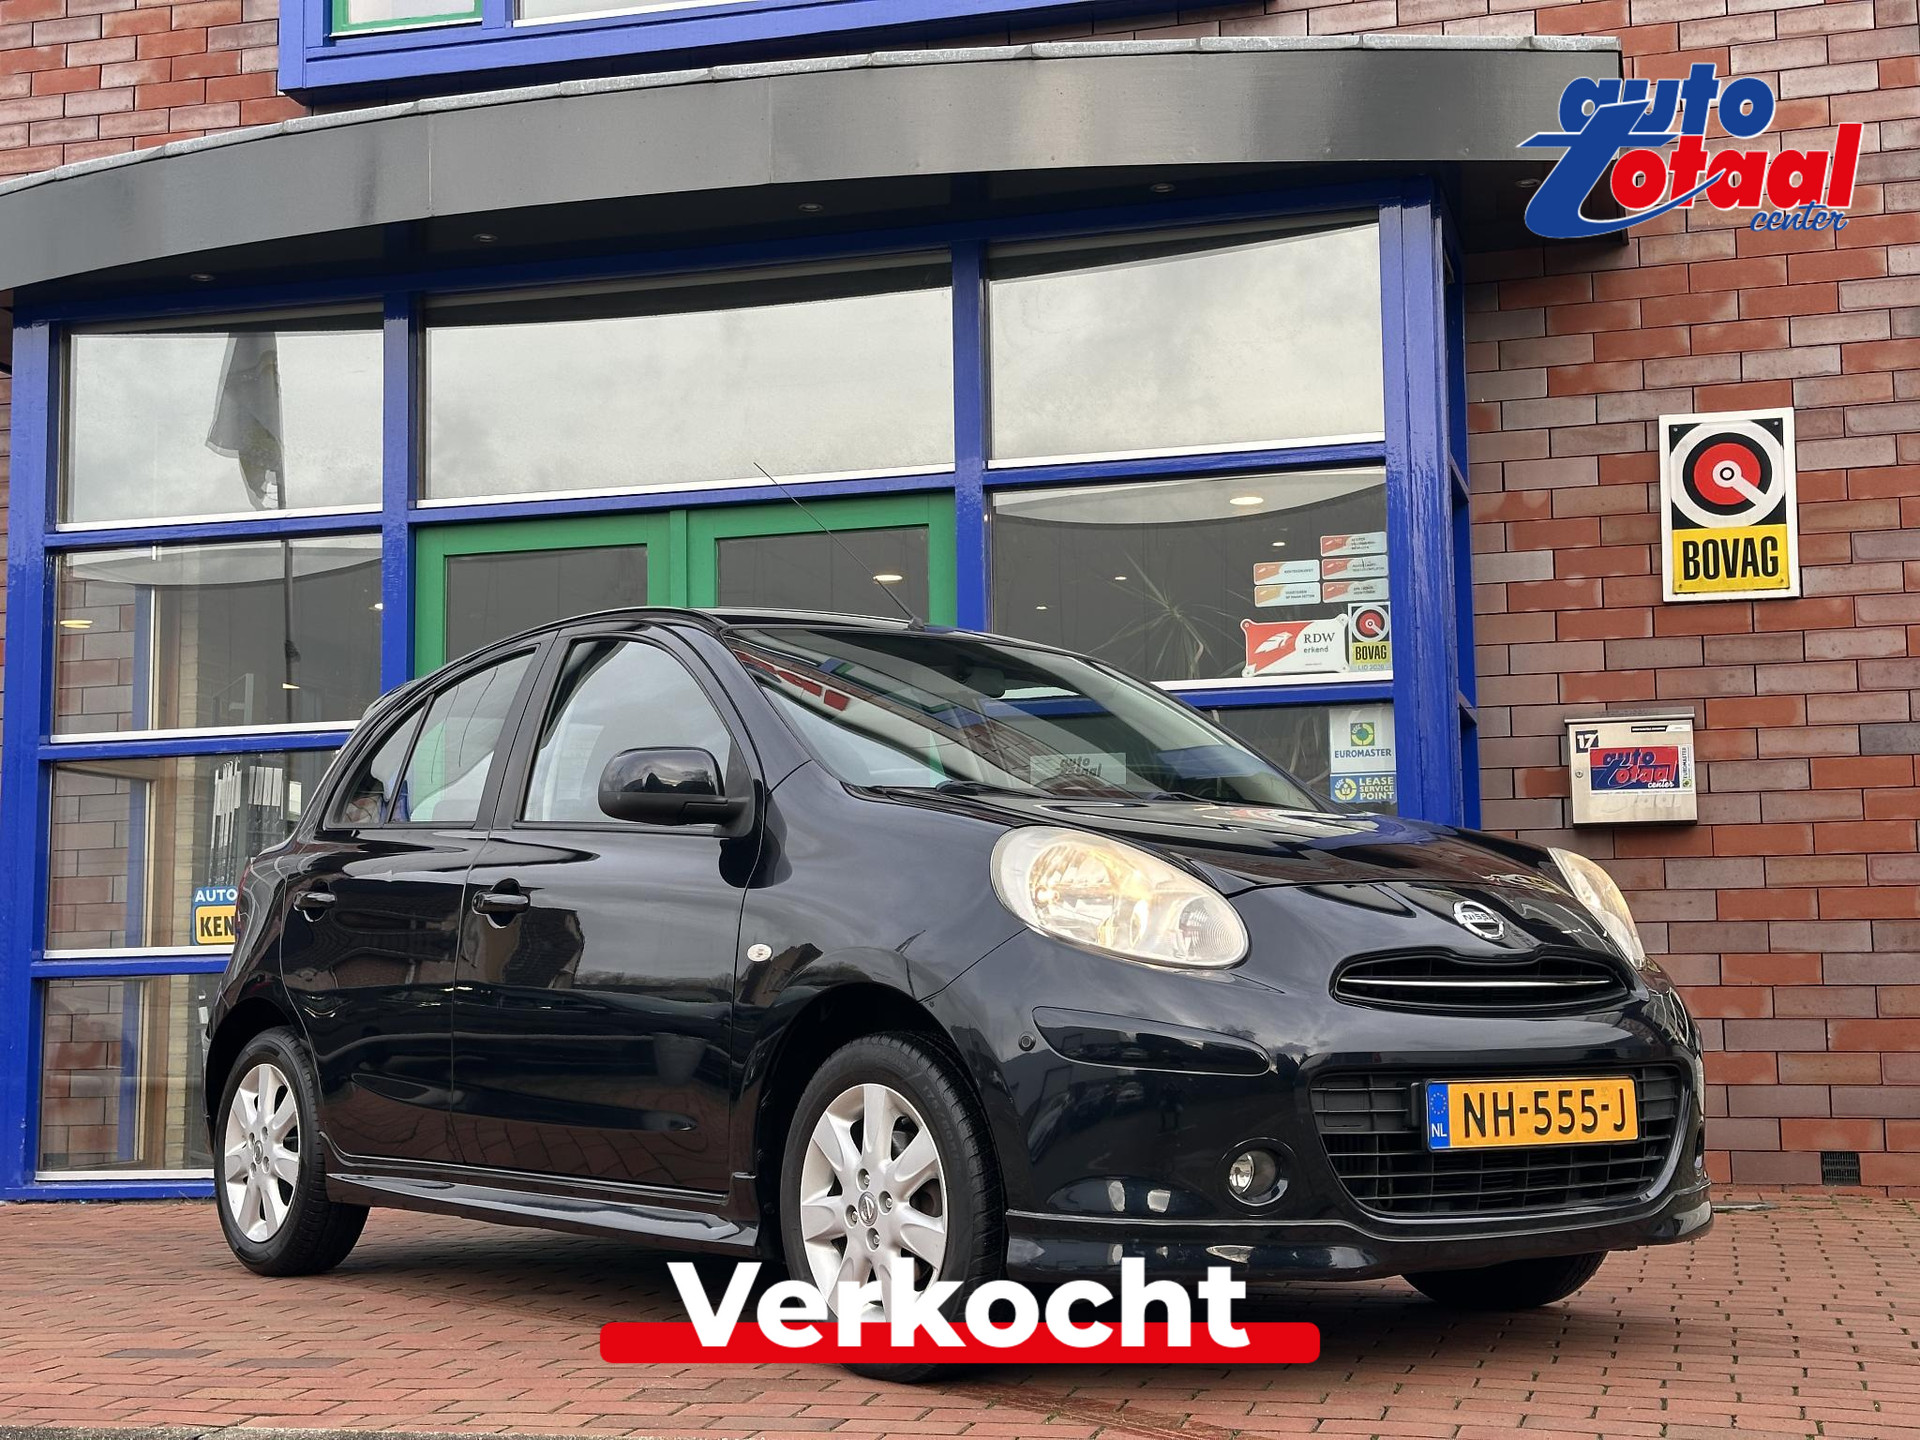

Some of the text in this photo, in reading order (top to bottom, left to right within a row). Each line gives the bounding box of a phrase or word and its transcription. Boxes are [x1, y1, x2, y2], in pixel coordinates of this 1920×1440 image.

[1682, 536, 1779, 580] BOVAG
[1303, 632, 1335, 643] RDW
[1303, 646, 1329, 654] erkend
[1355, 645, 1387, 661] BOVAG
[1576, 733, 1599, 749] 17
[1334, 749, 1392, 758] EUROMASTER
[1359, 777, 1394, 786] LEASE
[1647, 778, 1675, 789] center
[1359, 785, 1394, 793] SERVICE
[1360, 792, 1395, 800] POINT
[195, 889, 238, 902] AUTO
[1431, 1088, 1626, 1138] NL NH-555-J
